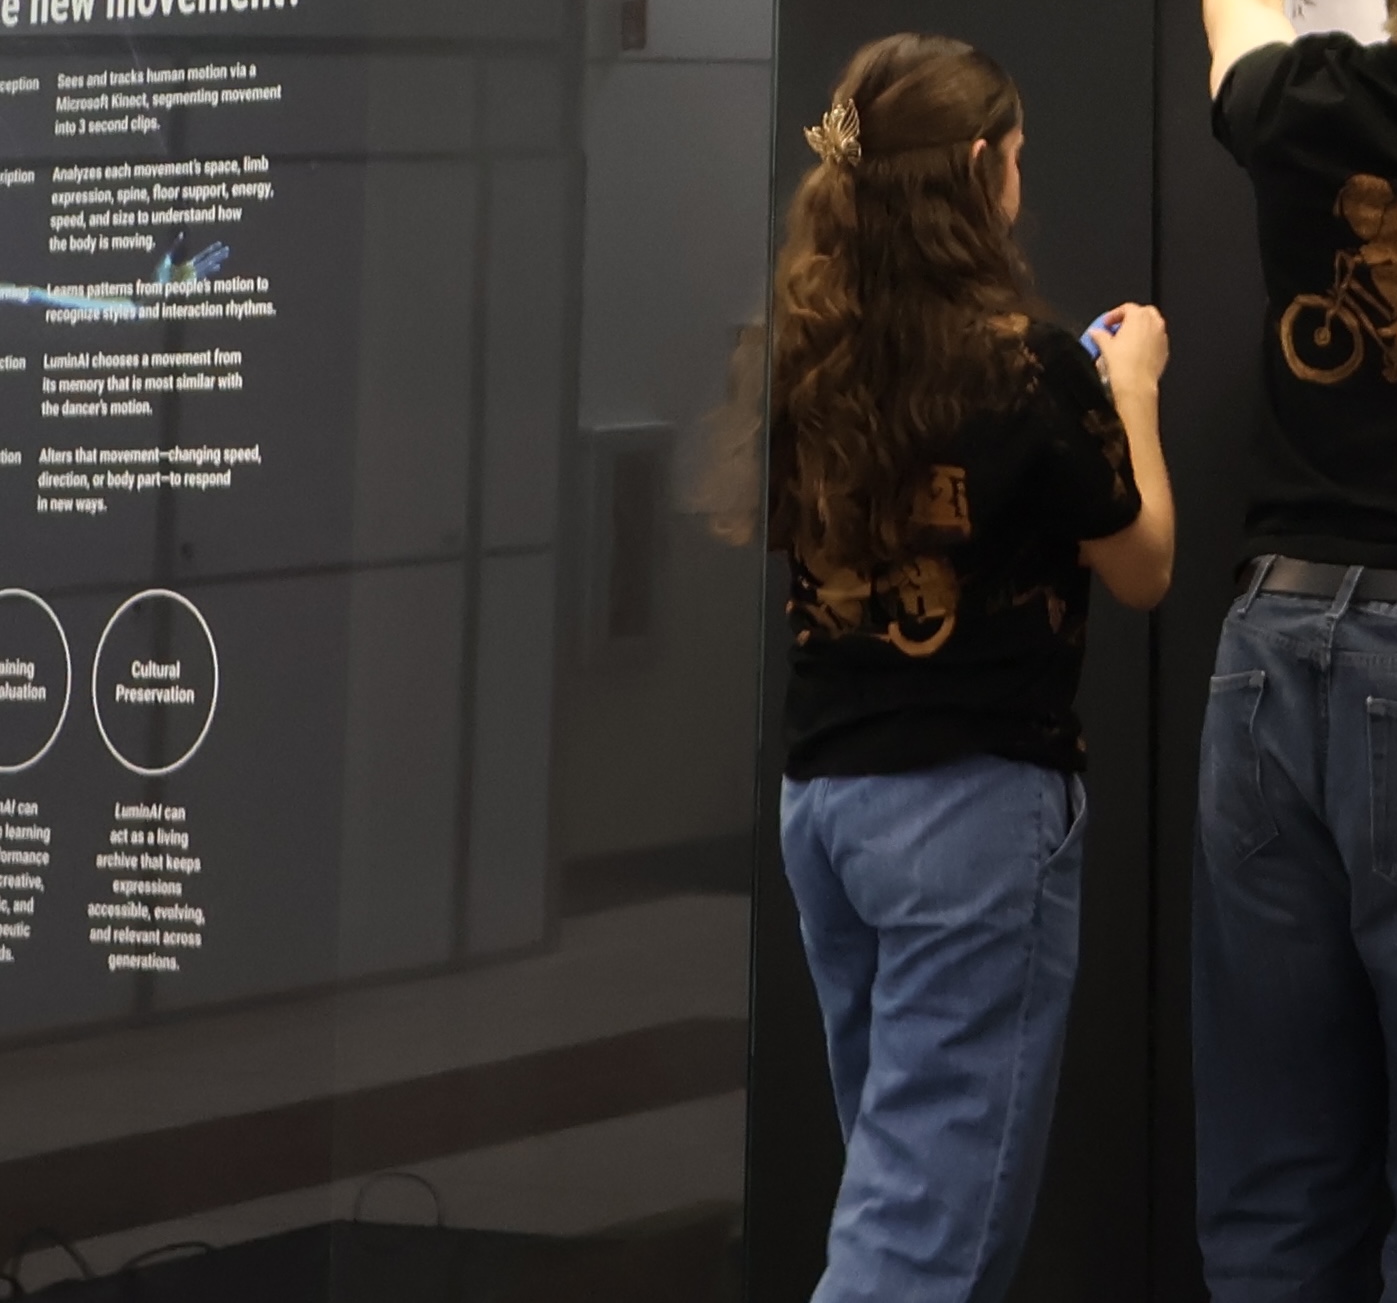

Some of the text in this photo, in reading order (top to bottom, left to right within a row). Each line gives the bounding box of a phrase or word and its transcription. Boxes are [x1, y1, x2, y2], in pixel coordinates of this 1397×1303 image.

[58, 63, 247, 90] Sees and tracks human motion via
[56, 84, 282, 112] Microsoft segmenting movement
[54, 115, 160, 136] into second clips.
[52, 154, 269, 185] Analyzes each space, limb
[51, 181, 274, 209] expression, spine, floor support, energy,
[49, 205, 242, 231] speed, and to understand how
[49, 232, 156, 254] the body moving.
[136, 279, 162, 295] from
[214, 277, 254, 294] motion
[257, 276, 269, 291] to
[139, 298, 277, 320] and interaction rhythms.
[43, 347, 242, 370] LuminAI chooses movement from
[58, 372, 243, 397] memory that most similar with
[41, 398, 152, 416] the motion.
[38, 443, 262, 465] Alters that speed,
[38, 468, 231, 491] direction, or body respond
[50, 497, 107, 516] new ways.
[131, 659, 181, 679] Cultural
[115, 684, 195, 704] Preservation
[164, 805, 186, 821] can
[5, 822, 51, 845] learning
[110, 827, 190, 850] act as living
[96, 851, 201, 874] archive that keeps
[112, 878, 183, 897] expressions
[13, 896, 35, 915] and
[87, 901, 206, 927] accessible, evolving,
[89, 924, 202, 948] and relevant across
[108, 951, 180, 972] generations.
